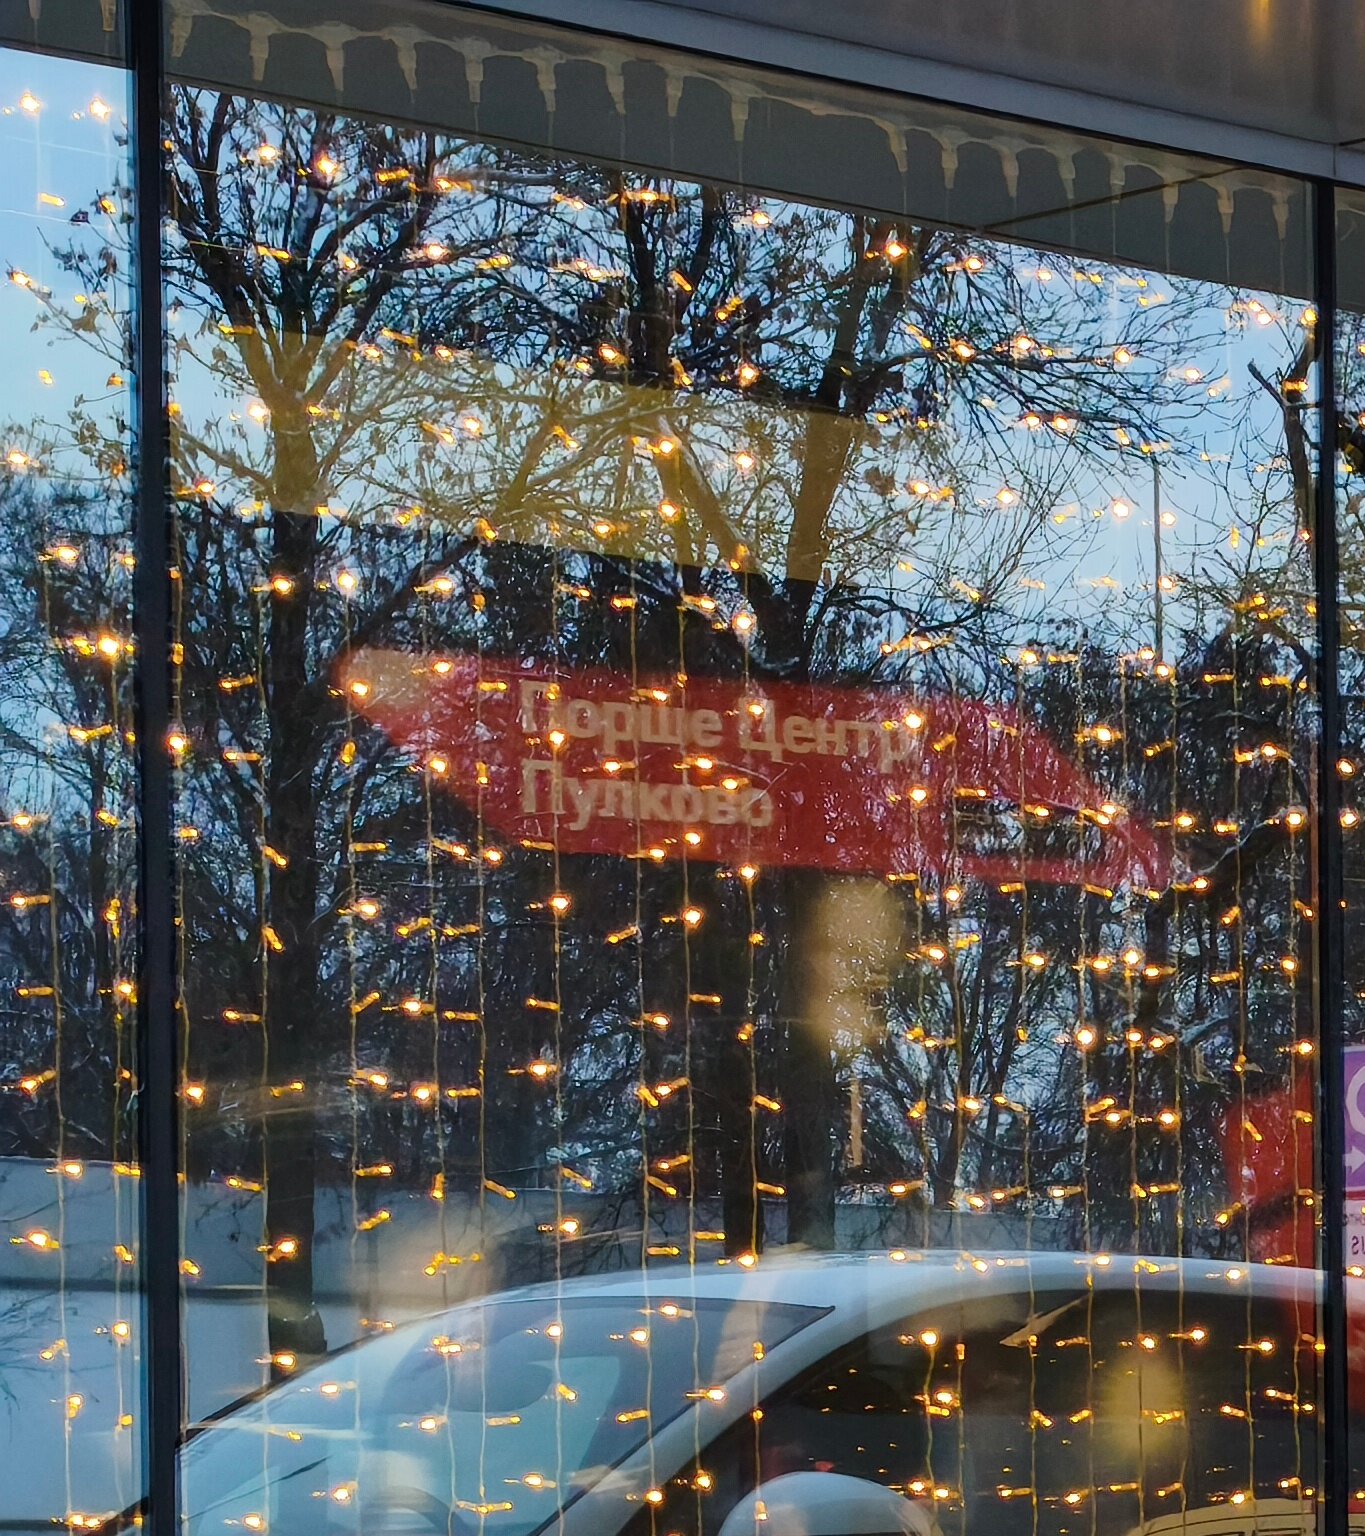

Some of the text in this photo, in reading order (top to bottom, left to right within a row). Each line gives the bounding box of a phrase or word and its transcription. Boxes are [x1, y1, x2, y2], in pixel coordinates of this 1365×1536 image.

[520, 679, 913, 774] Порше Центр
[520, 758, 774, 832] Пулково
